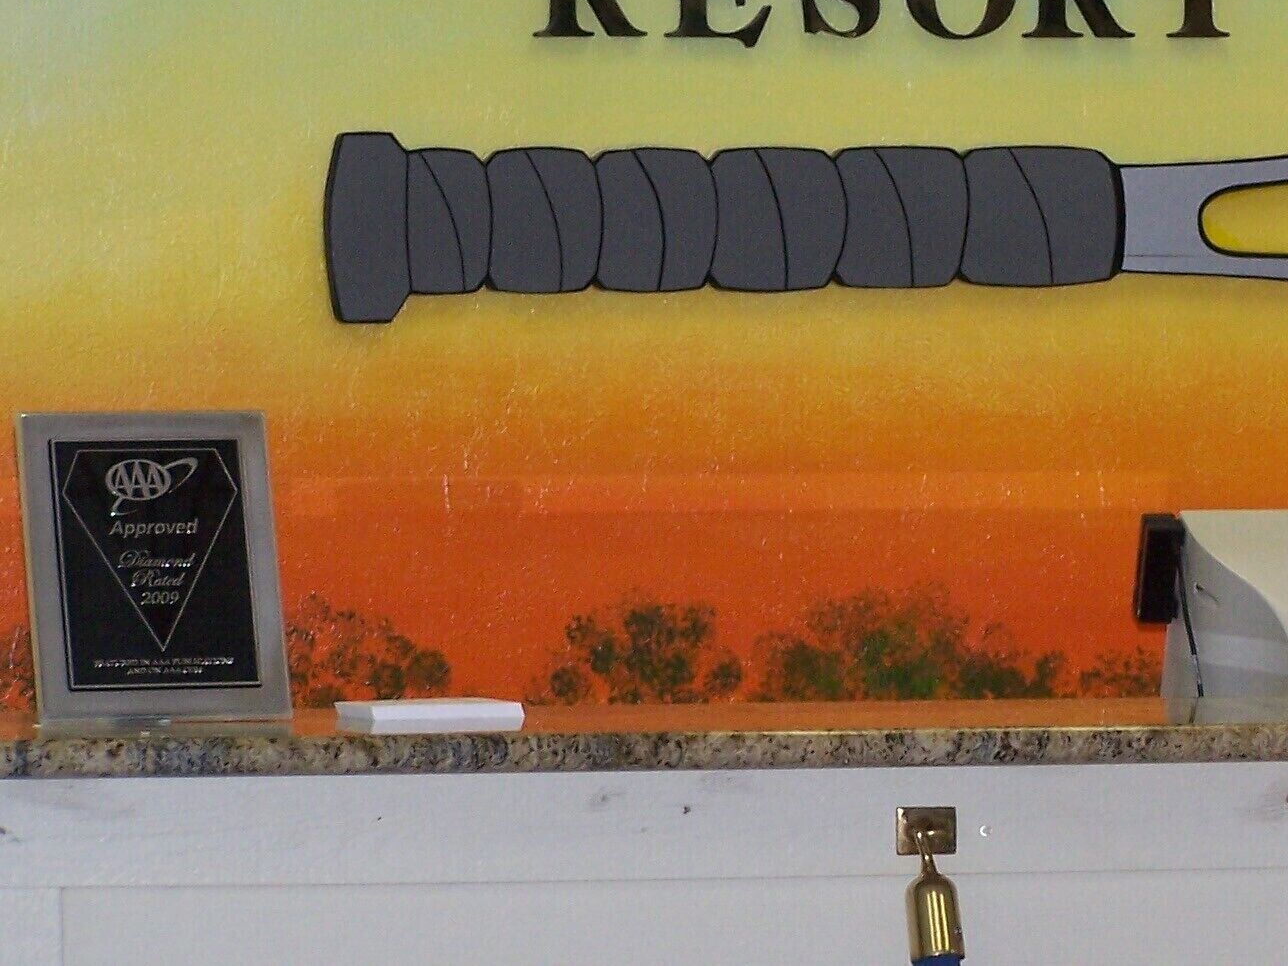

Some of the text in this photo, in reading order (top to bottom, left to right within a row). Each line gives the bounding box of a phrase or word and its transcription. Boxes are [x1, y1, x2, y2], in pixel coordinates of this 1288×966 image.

[113, 460, 166, 500] AAA
[109, 518, 199, 538] Approved
[118, 549, 196, 568] Diamond
[131, 569, 186, 587] Rated
[141, 591, 180, 605] 2009
